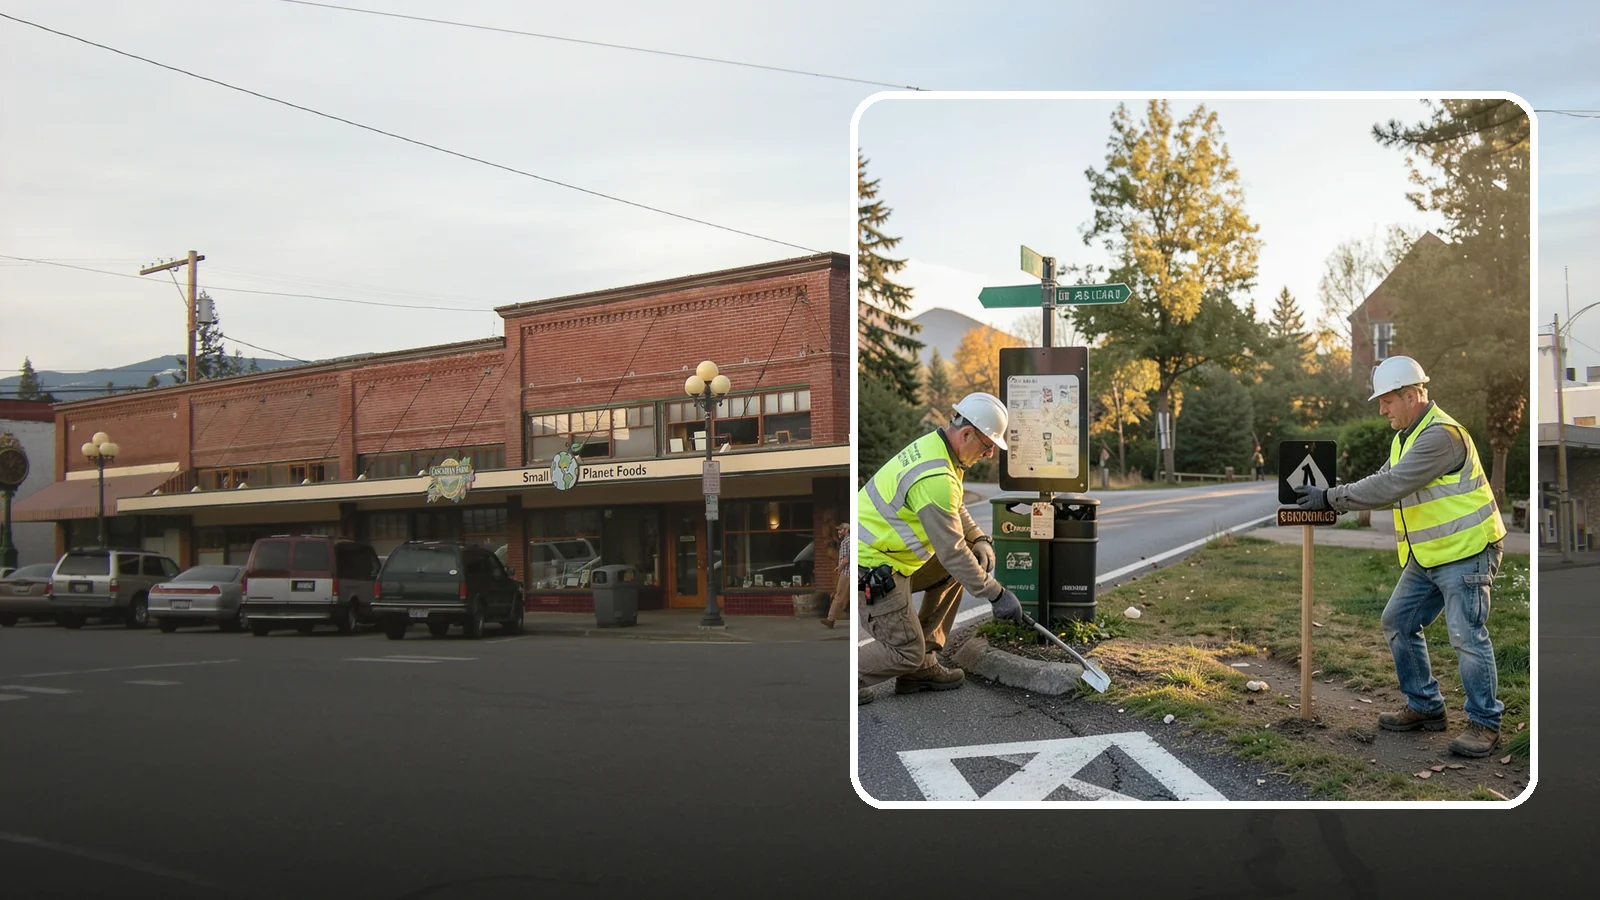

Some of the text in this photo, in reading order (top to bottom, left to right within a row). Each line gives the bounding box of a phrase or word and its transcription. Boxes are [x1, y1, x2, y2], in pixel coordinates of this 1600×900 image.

[523, 464, 647, 483] Small Planet Foods
